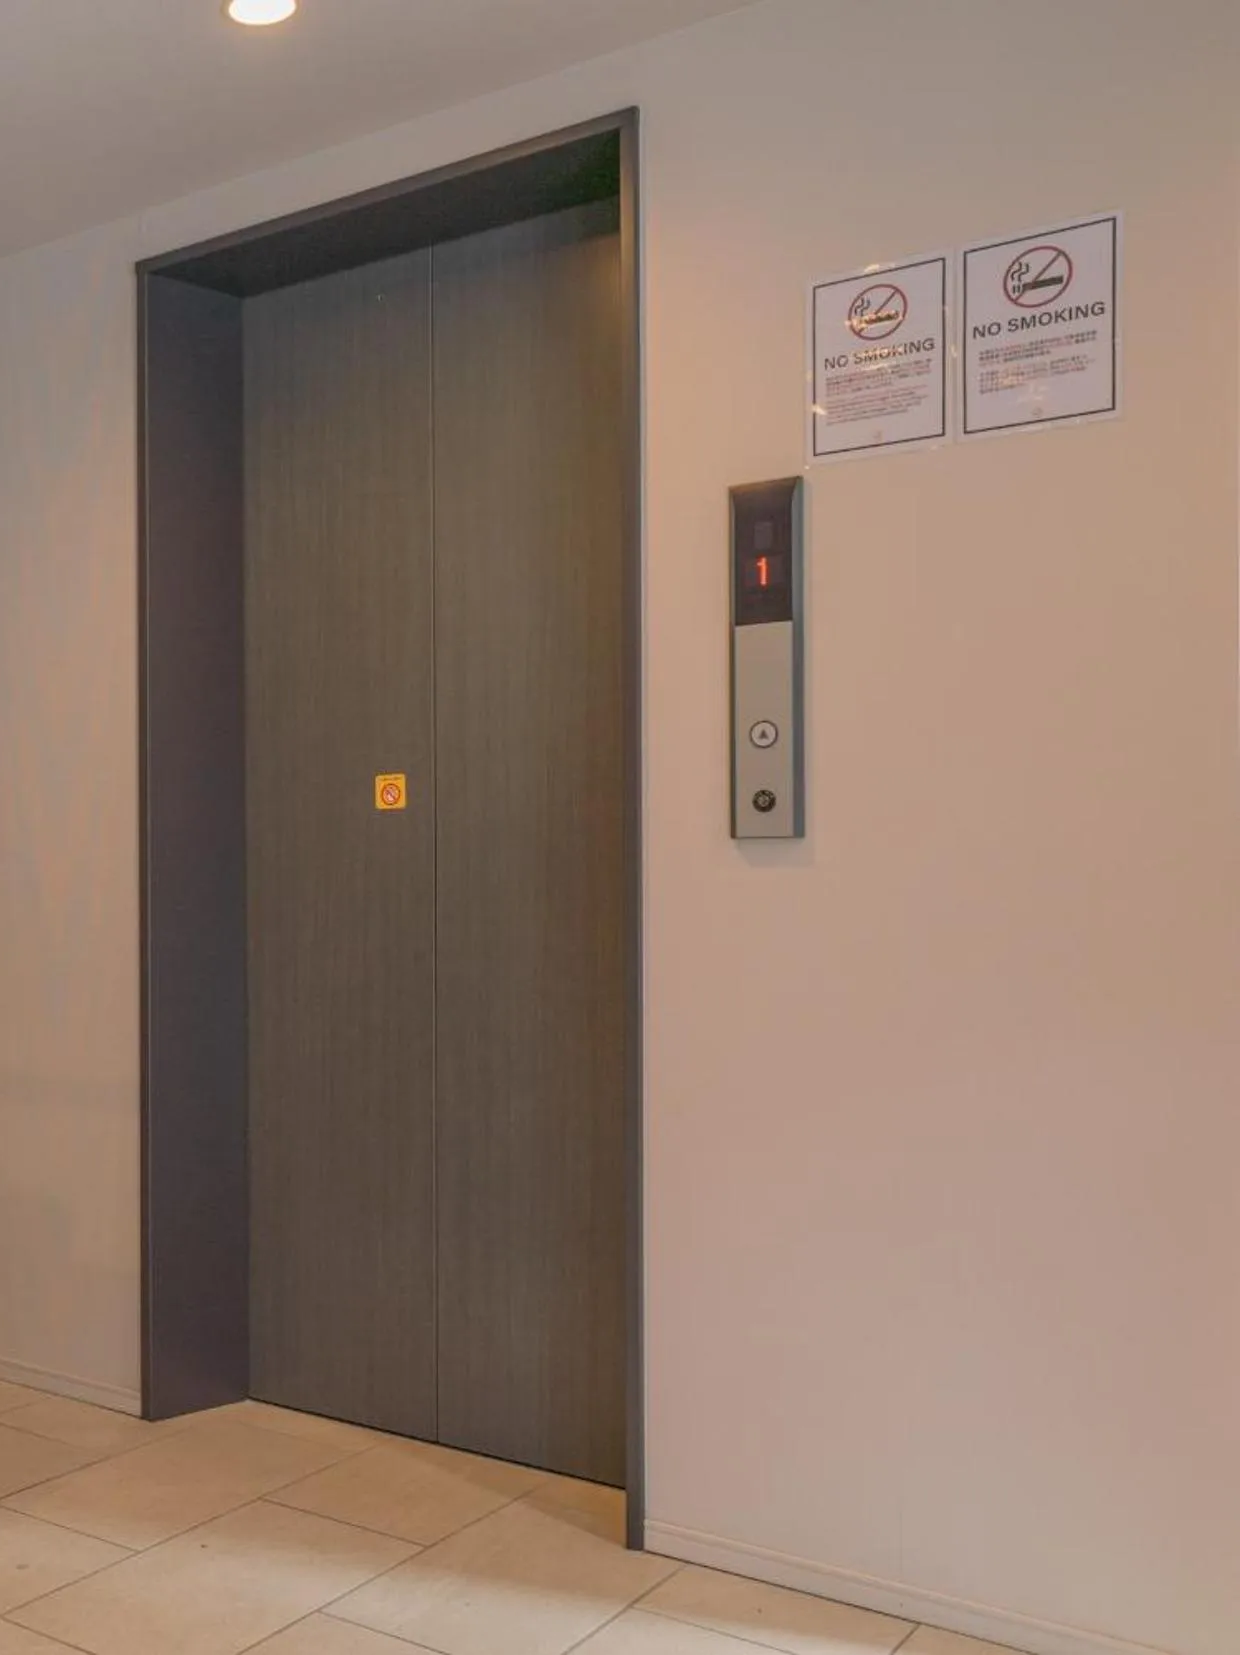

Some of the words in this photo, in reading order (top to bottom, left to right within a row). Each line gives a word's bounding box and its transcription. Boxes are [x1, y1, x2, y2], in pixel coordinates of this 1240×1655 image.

[972, 321, 1001, 340] NO
[1007, 301, 1106, 333] SMOKING
[824, 354, 849, 371] NO
[853, 337, 936, 366] SMOKING
[757, 556, 767, 586] 1
